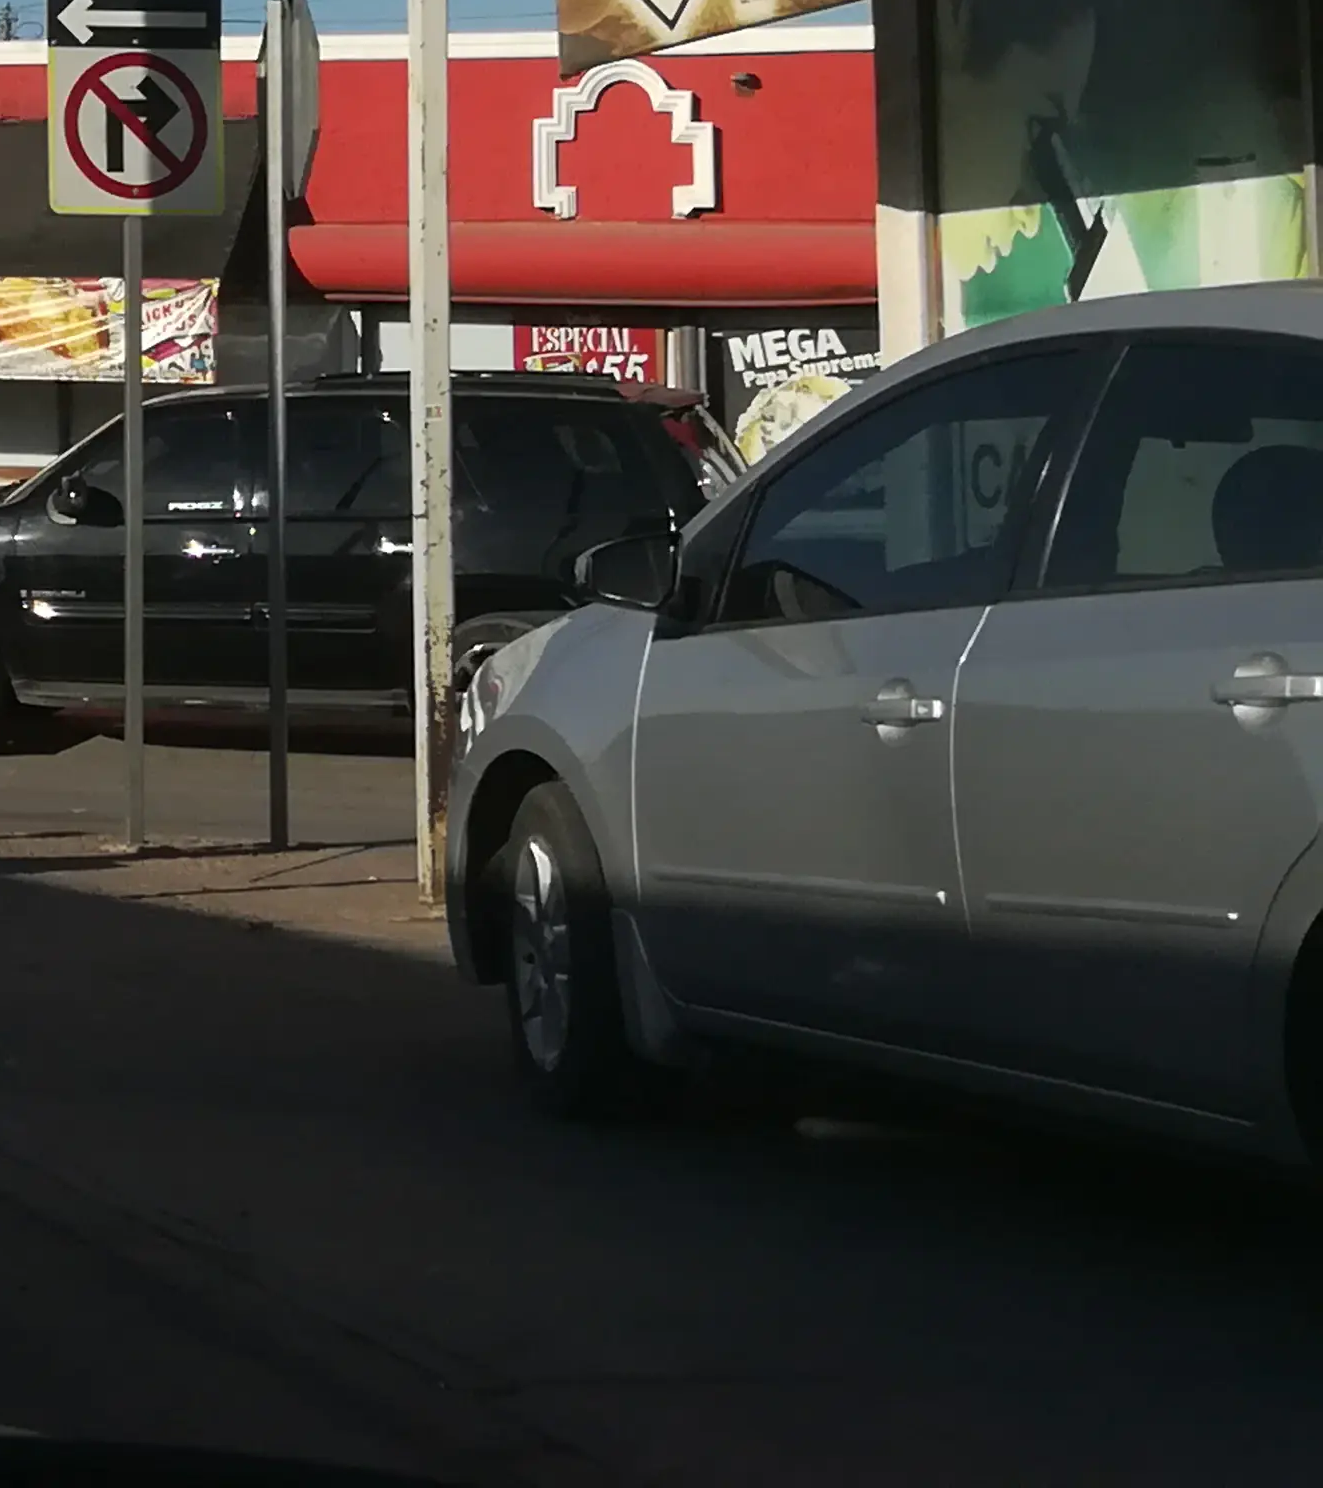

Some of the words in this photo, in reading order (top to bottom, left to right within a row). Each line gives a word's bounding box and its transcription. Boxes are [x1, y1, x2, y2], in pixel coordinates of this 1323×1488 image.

[532, 327, 638, 353] ESPECIAL
[728, 328, 847, 371] MEGA
[743, 369, 788, 388] Papa
